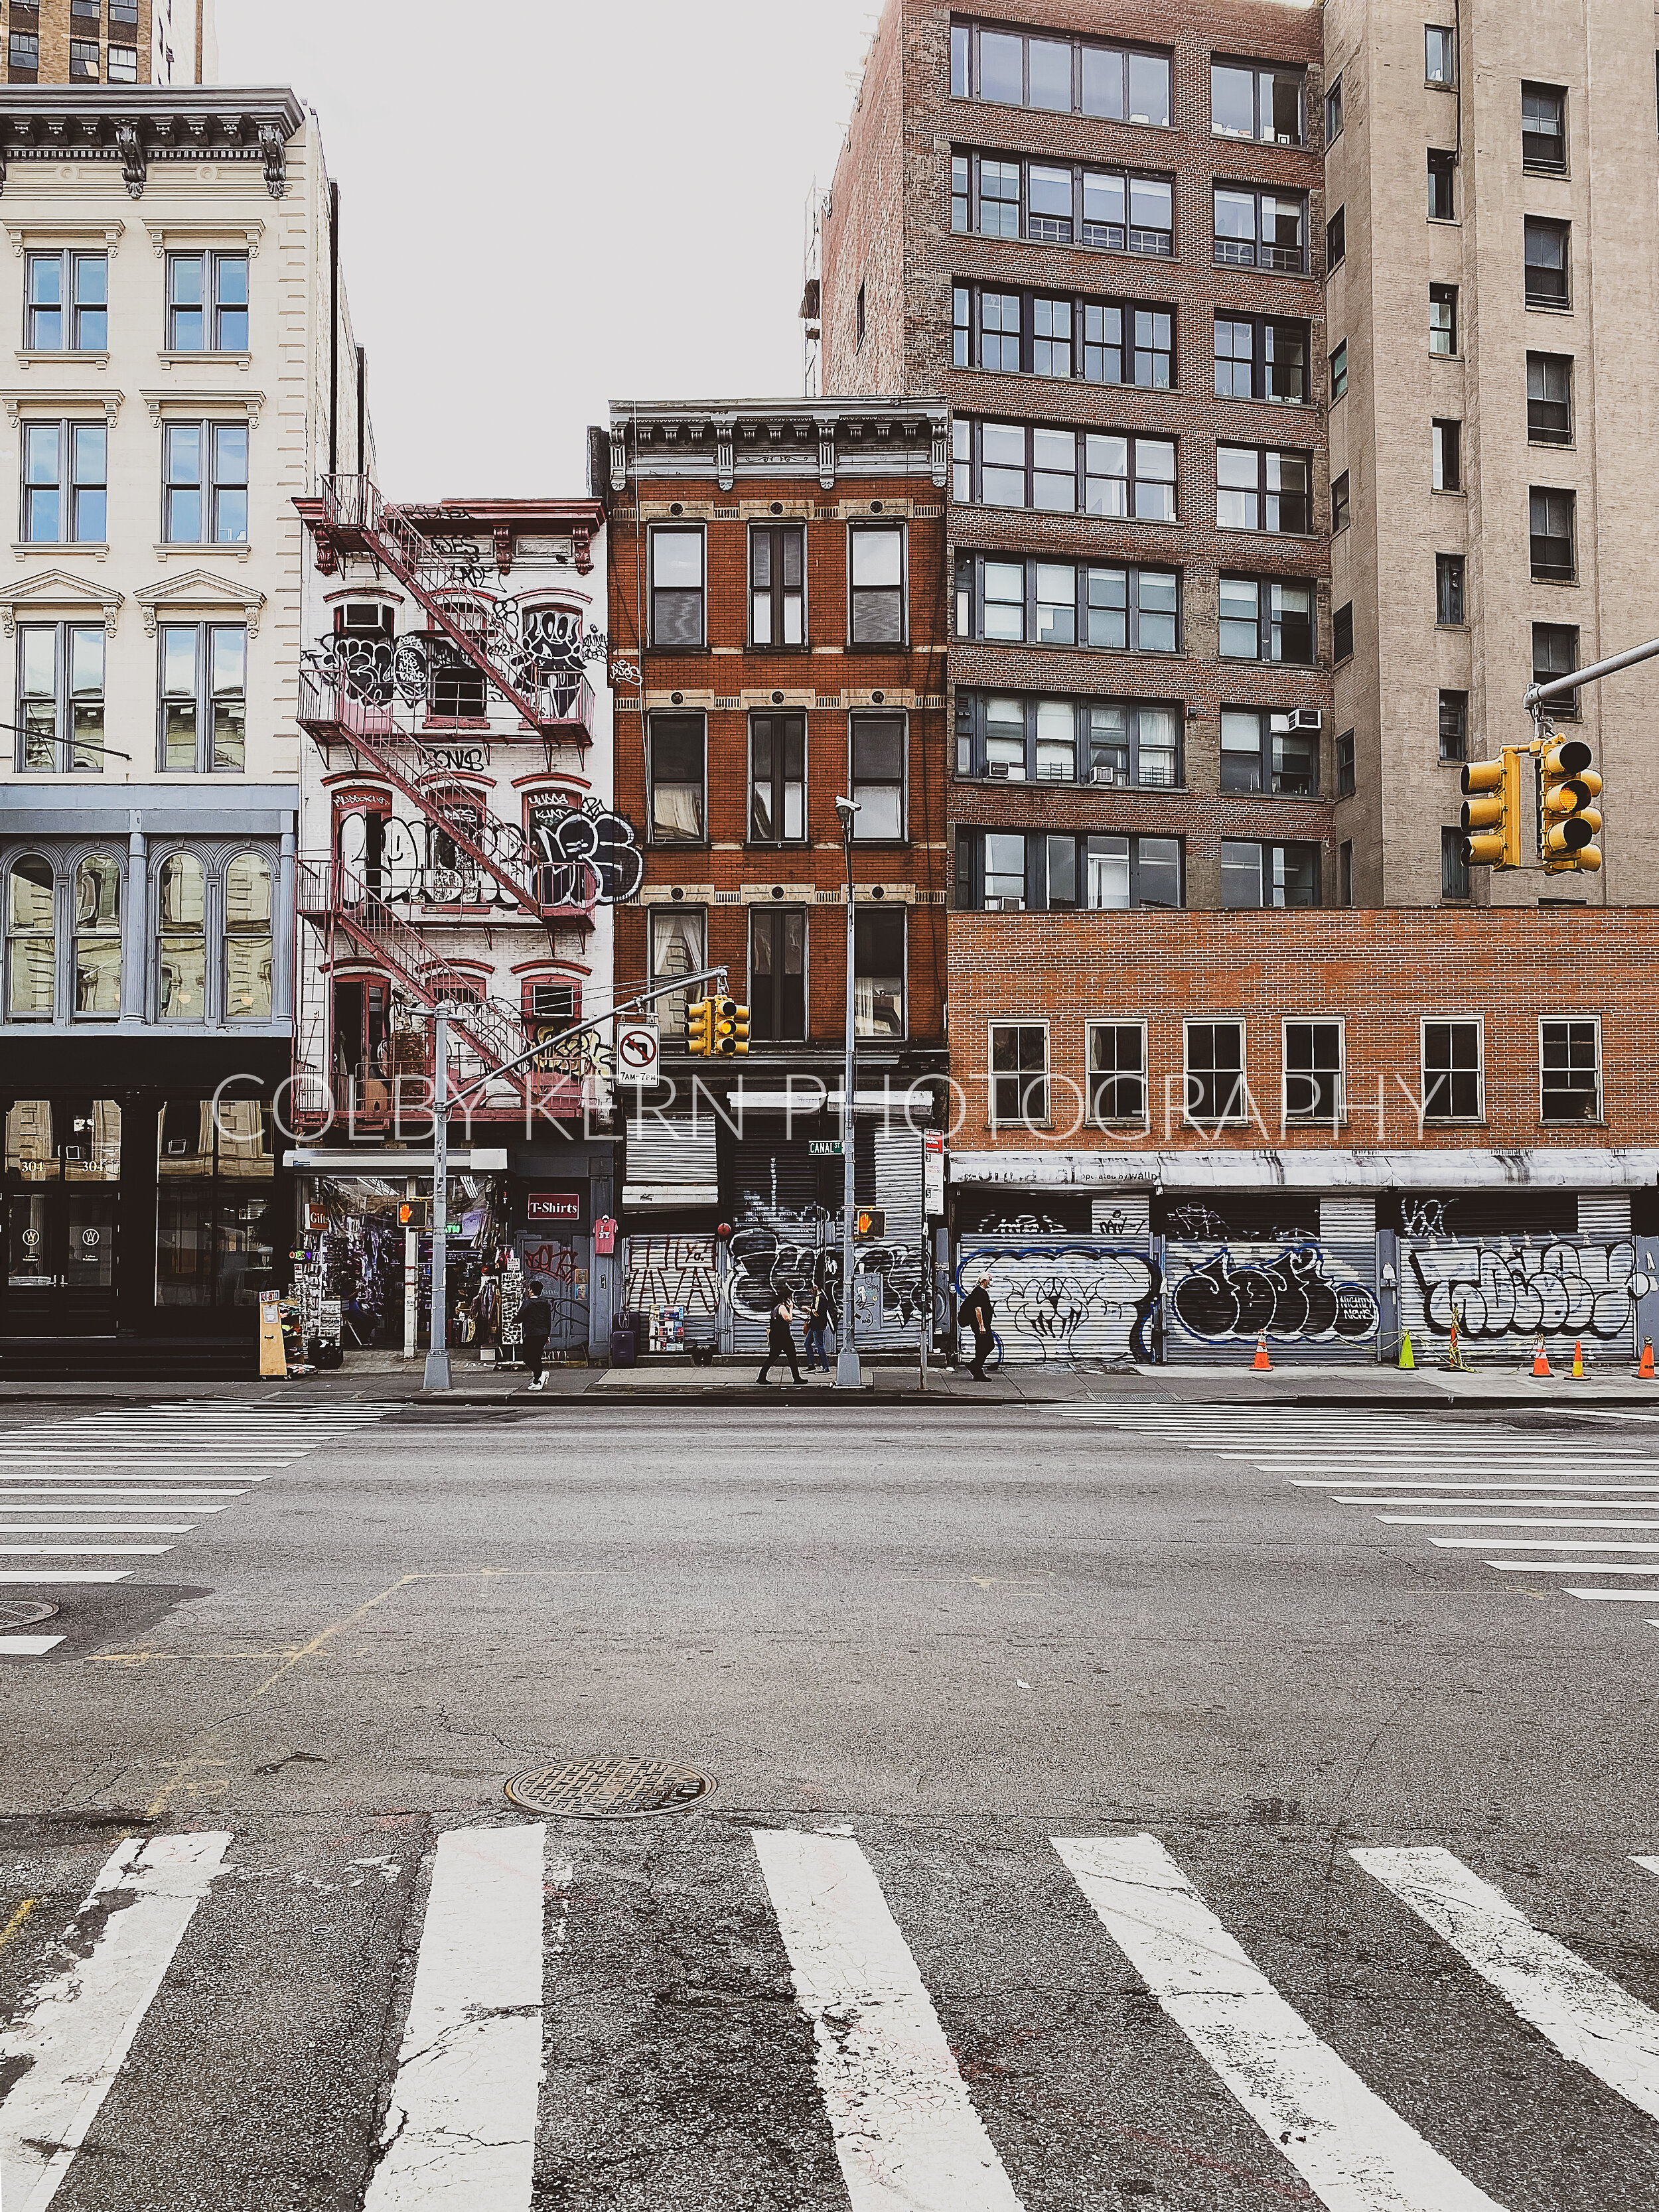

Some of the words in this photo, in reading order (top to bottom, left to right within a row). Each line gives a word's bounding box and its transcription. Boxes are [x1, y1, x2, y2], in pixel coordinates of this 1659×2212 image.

[620, 1071, 656, 1081] 7AM-7PM
[810, 1142, 834, 1153] CANAL
[21, 1161, 44, 1172] 304
[82, 1161, 105, 1172] 304
[530, 1202, 577, 1214] T-Shirts
[1344, 1309, 1374, 1320] NEWS
